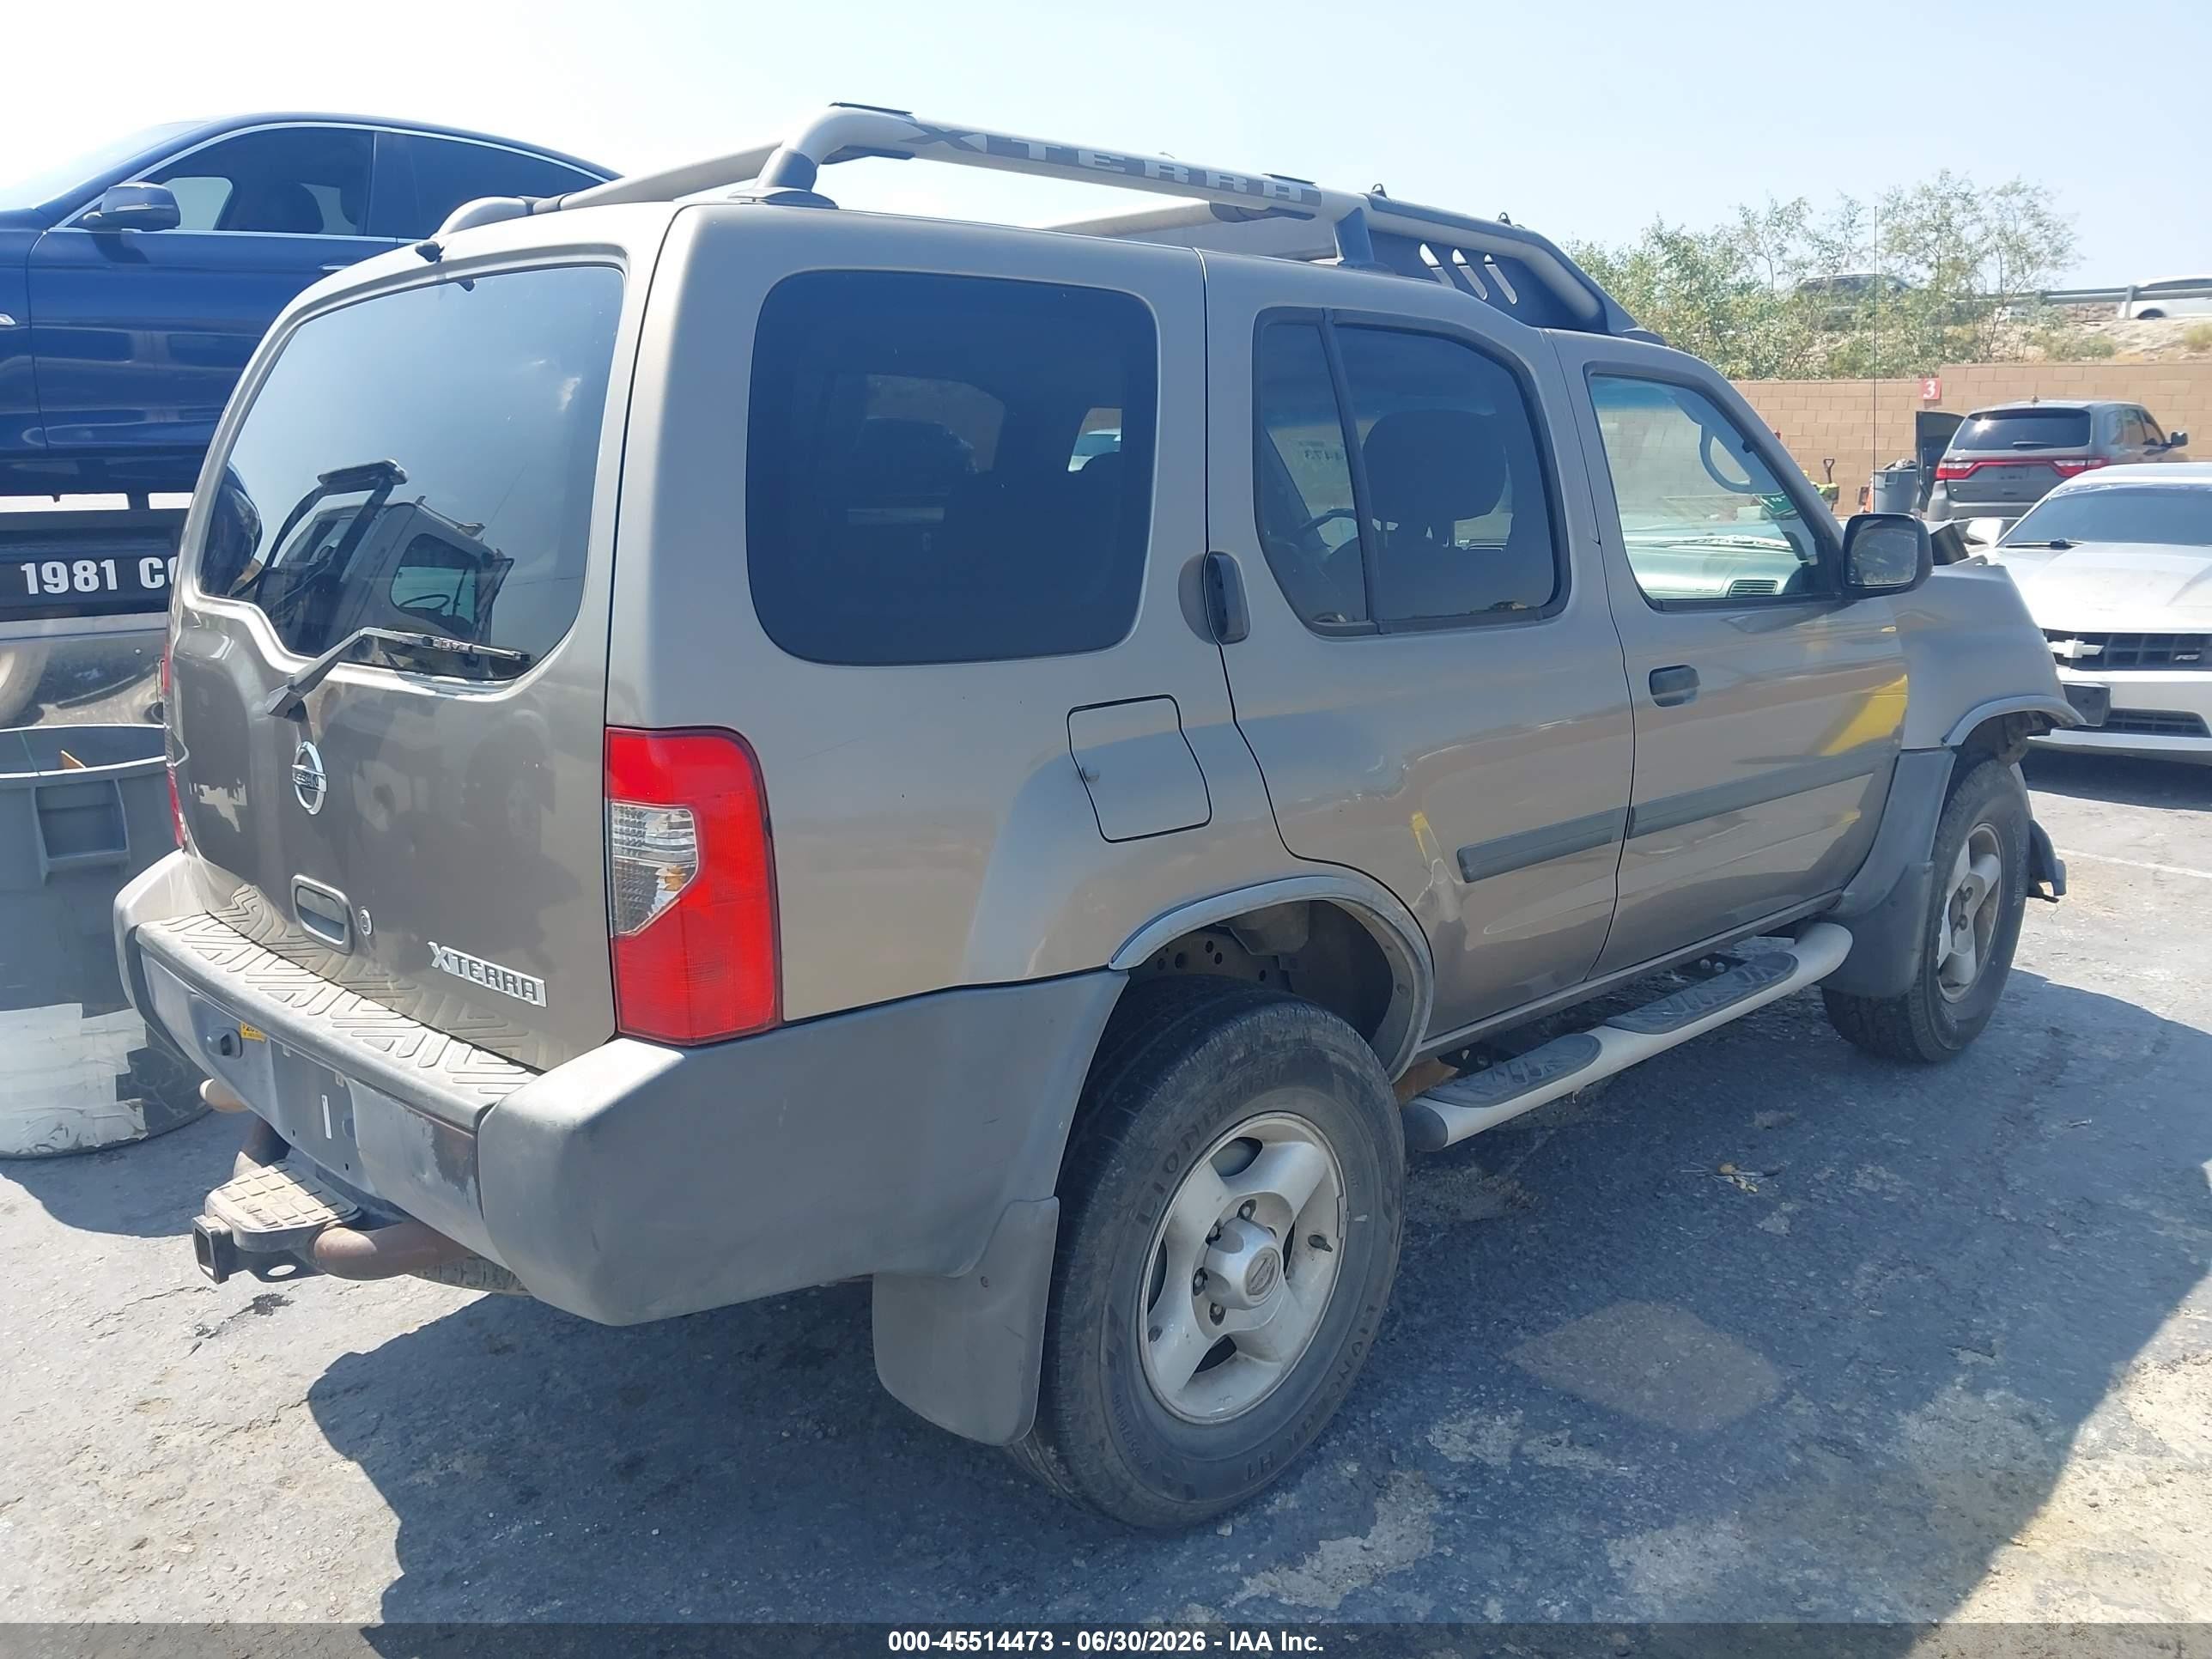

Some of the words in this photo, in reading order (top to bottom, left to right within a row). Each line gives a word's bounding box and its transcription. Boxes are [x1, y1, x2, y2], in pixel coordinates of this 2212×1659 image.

[896, 122, 1304, 204] XTERRA
[1923, 380, 1936, 399] 3
[21, 559, 118, 594] 1981
[428, 941, 546, 1007] XTERRA
